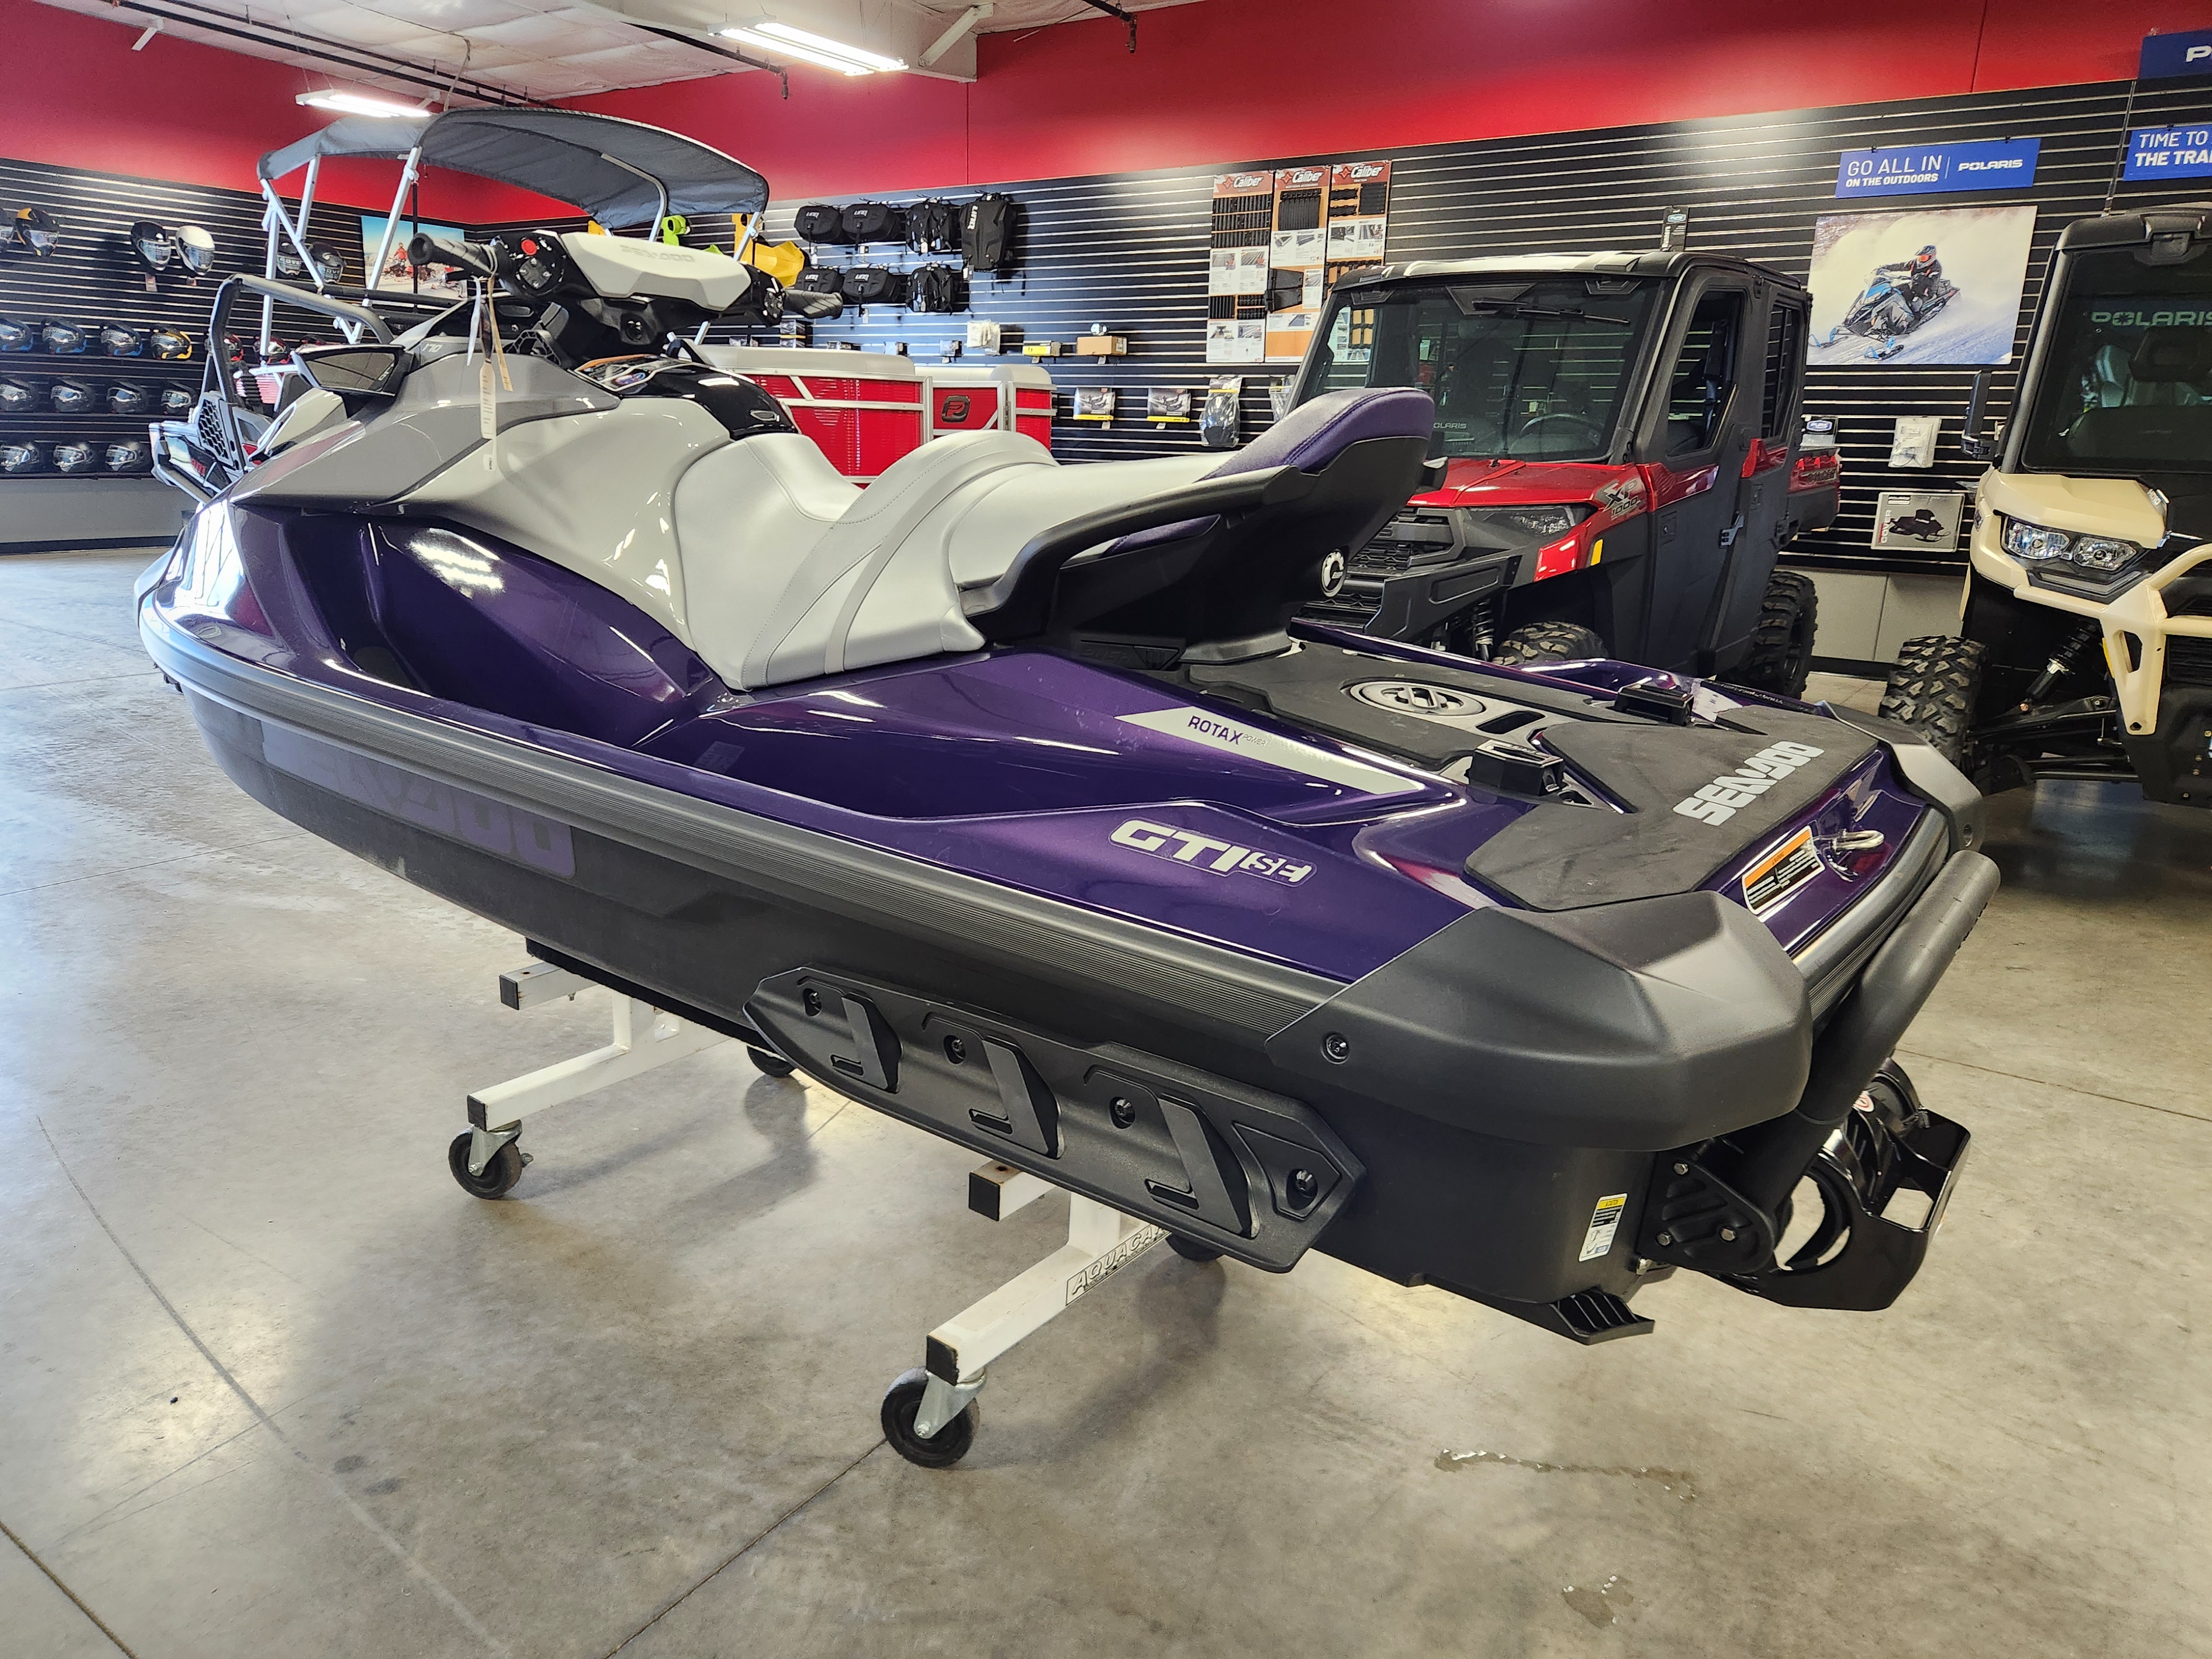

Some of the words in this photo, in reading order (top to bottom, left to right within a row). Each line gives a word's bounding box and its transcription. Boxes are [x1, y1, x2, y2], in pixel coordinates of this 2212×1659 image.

[2138, 132, 2182, 149] TIME
[2185, 131, 2208, 146] TO
[1847, 160, 1872, 176] GO
[1877, 156, 1915, 174] ALL
[1921, 154, 1943, 171] IN
[1958, 159, 2023, 171] POLARIS
[2134, 151, 2171, 167] THE
[1292, 170, 1324, 183] Caliber
[1351, 165, 1384, 178] Caliber
[1233, 175, 1264, 189] Caliber
[1845, 178, 1860, 187] ON
[1863, 176, 1882, 186] THE
[1883, 173, 1939, 185] OUTDOORS
[422, 343, 443, 353] 170
[1611, 495, 1640, 518] 1000
[1187, 715, 1244, 745] ROTAX
[1243, 733, 1266, 747] POWER
[1109, 819, 1251, 873] GTI
